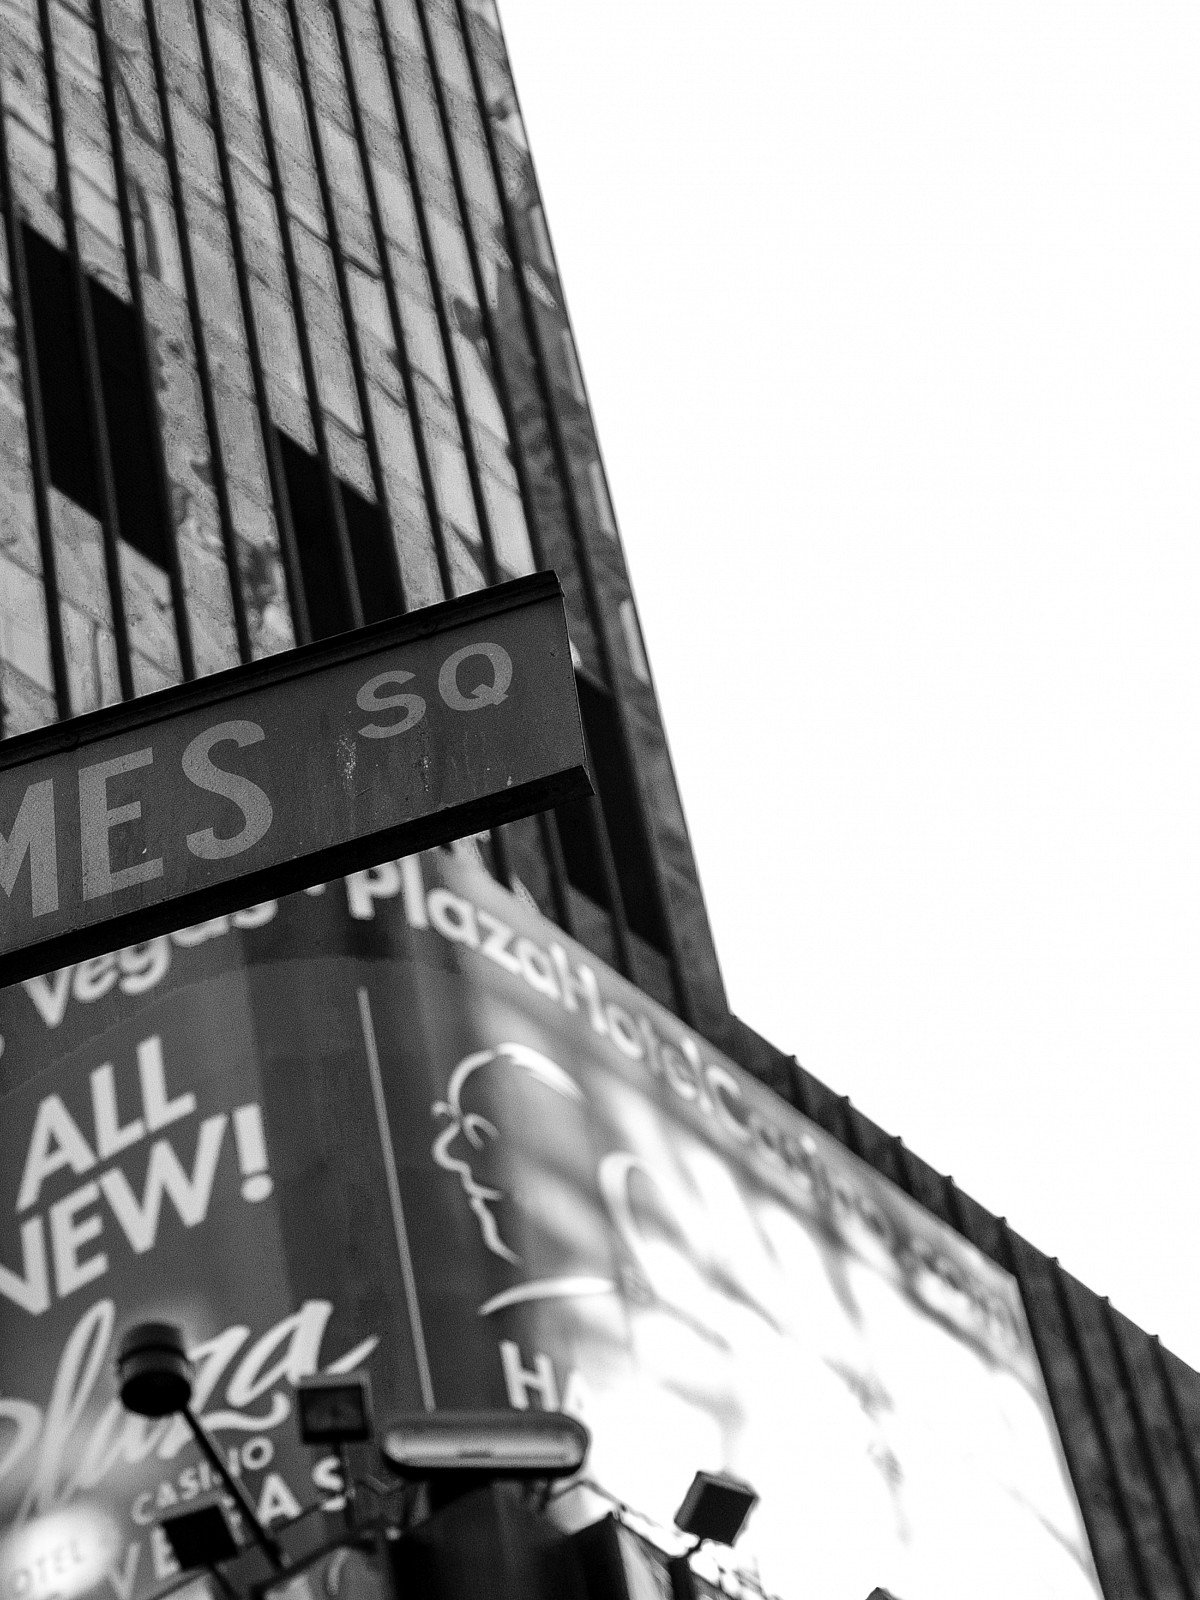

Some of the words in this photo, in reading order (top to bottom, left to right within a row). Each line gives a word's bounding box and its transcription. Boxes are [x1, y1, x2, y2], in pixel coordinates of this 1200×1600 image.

[355, 641, 514, 739] SQ
[15, 1033, 198, 1213] ALL
[106, 1455, 347, 1600] VEAS
